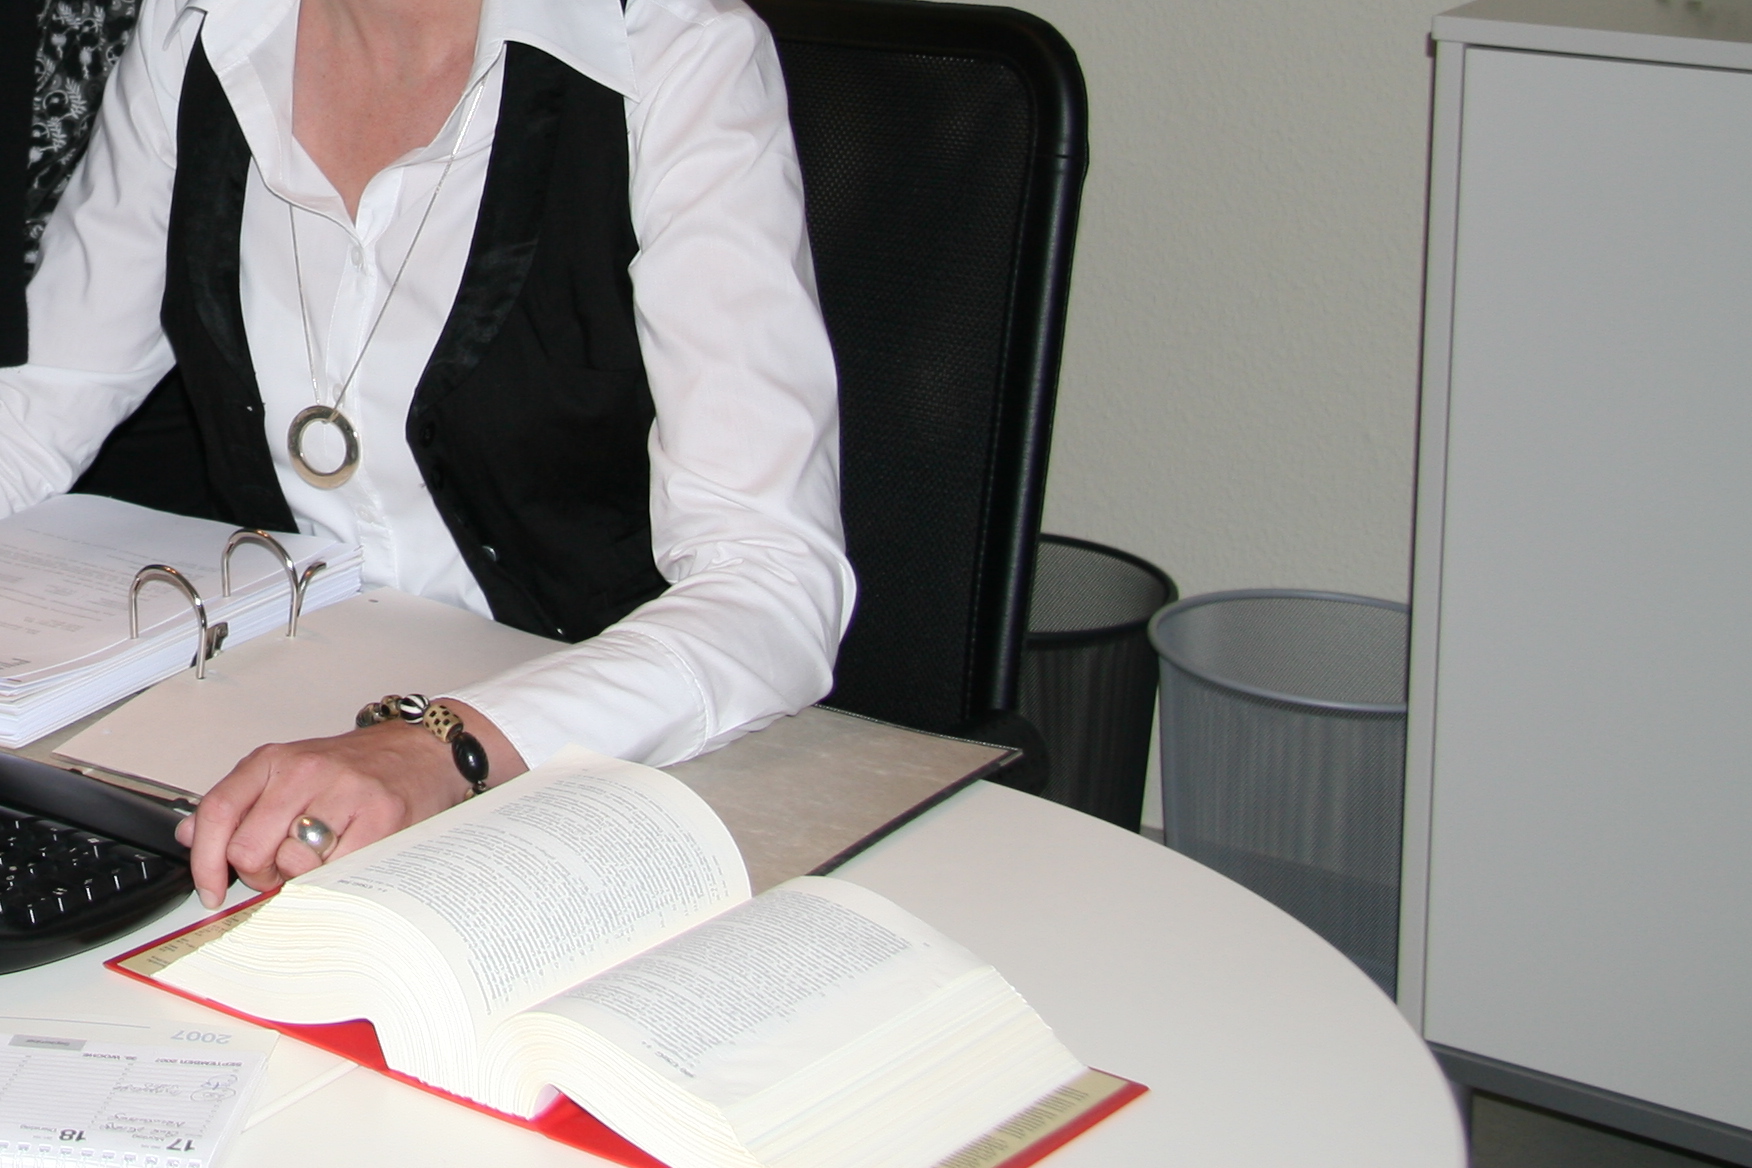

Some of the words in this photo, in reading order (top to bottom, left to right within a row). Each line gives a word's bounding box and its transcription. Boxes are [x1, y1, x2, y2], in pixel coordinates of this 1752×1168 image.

[170, 1029, 233, 1045] 2007
[82, 1052, 122, 1061] WOCHE
[179, 1058, 243, 1068] SEPTEMBER
[58, 1129, 87, 1142] 18
[166, 1138, 196, 1152] 17
